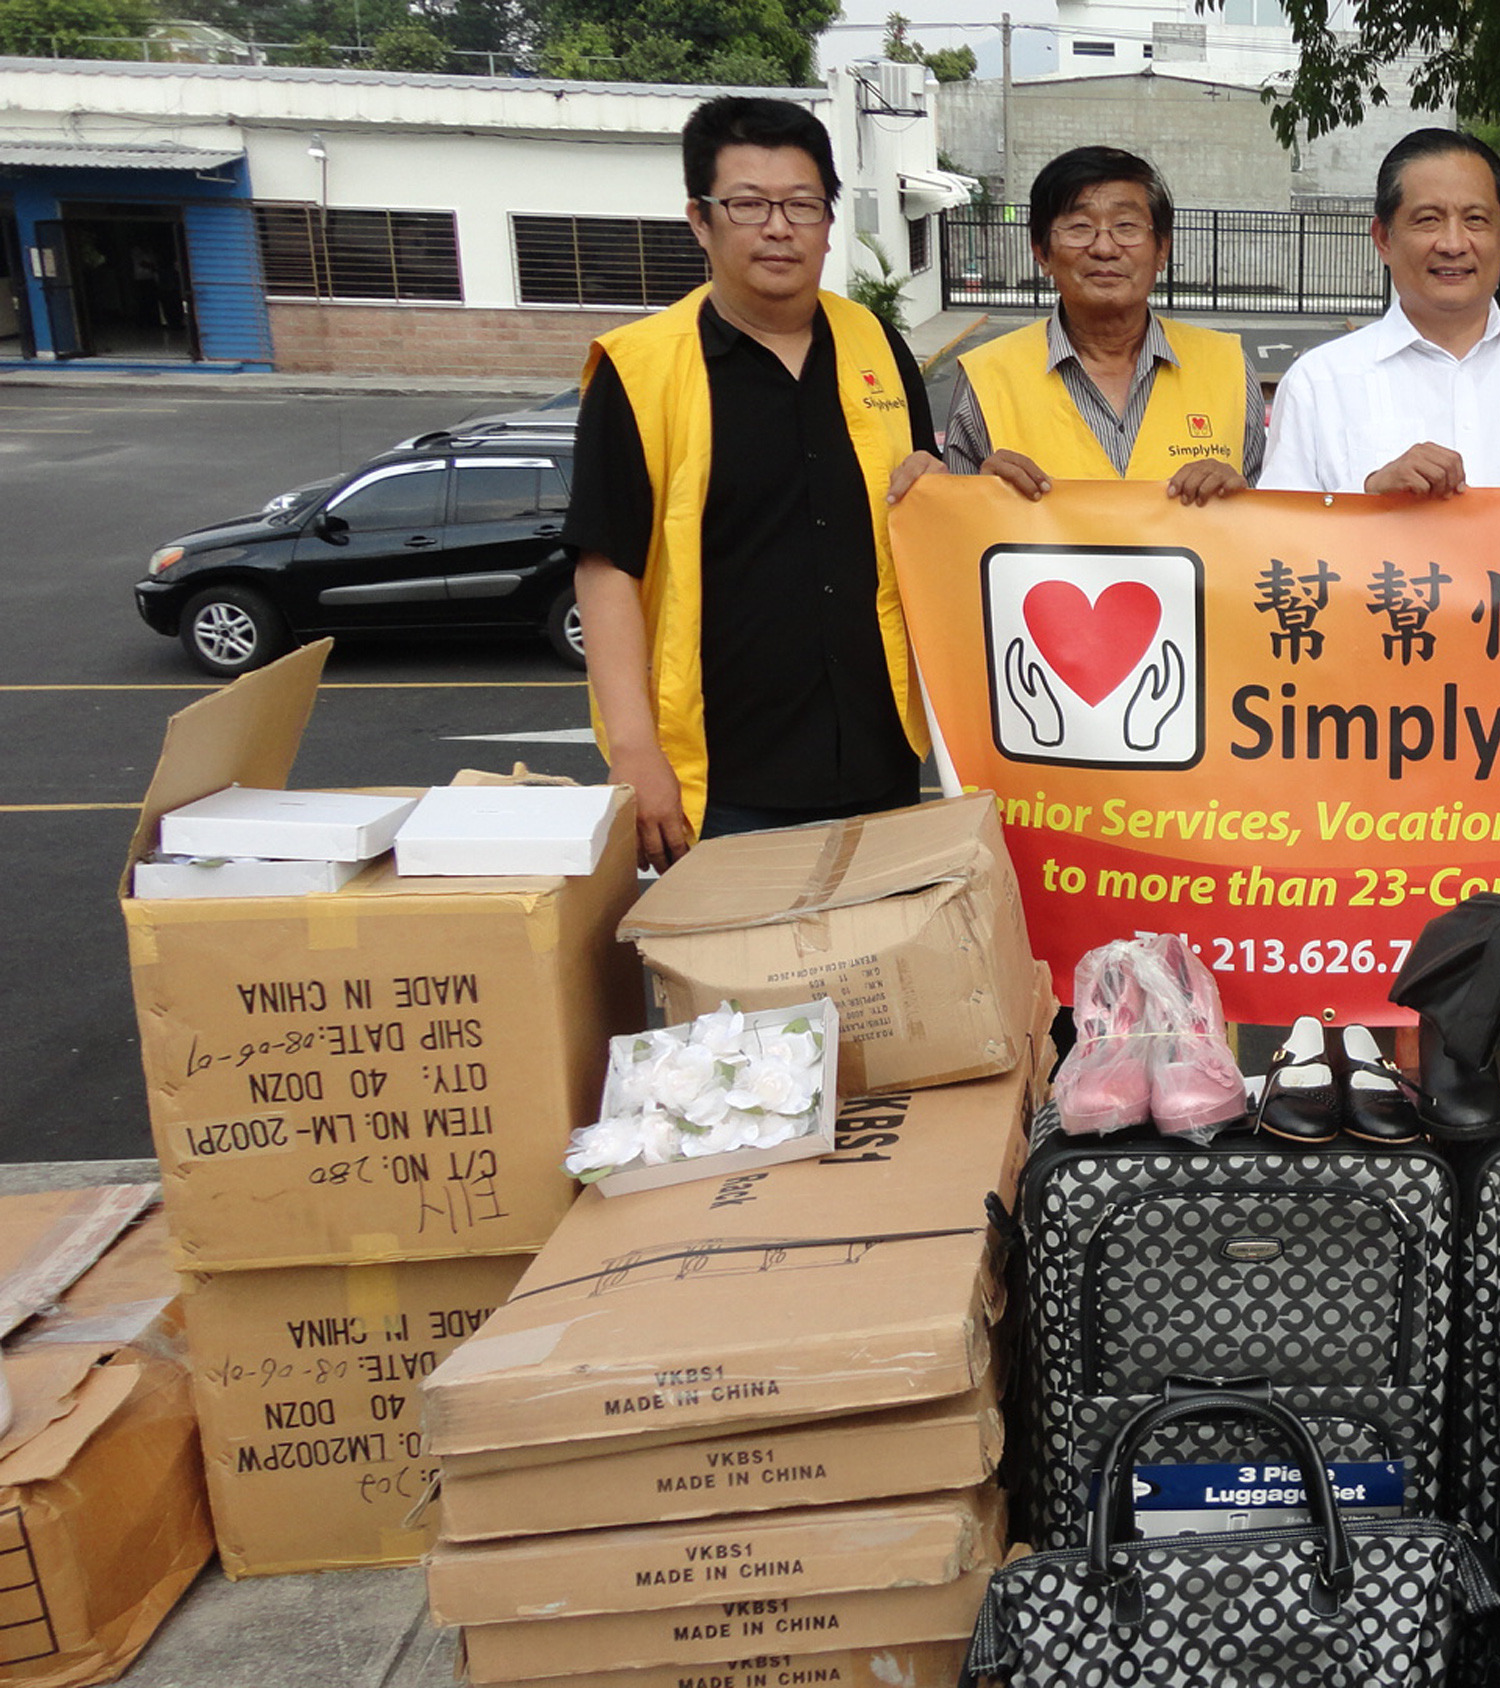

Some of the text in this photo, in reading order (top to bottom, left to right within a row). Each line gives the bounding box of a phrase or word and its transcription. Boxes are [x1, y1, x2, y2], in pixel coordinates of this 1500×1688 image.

[962, 785, 1092, 833] nior
[1101, 798, 1302, 847] Services,
[1043, 859, 1086, 893] to
[1098, 870, 1212, 905] more
[1228, 867, 1336, 907] than
[236, 973, 480, 1014] MADE IN CHINA
[319, 1022, 405, 1055] DATE:
[420, 1019, 483, 1050] SHIP
[249, 1062, 489, 1104] QTY: 40 DOZN
[365, 1110, 411, 1140] NO:
[424, 1105, 492, 1138] ITEM
[383, 1152, 430, 1184] NO:
[446, 1149, 498, 1181] C/T
[654, 1364, 726, 1388] VKBS1
[264, 1394, 406, 1430] 40 DOZN
[604, 1379, 781, 1416] MADE IN CHINA
[237, 1434, 387, 1473] LM2002PW
[706, 1449, 775, 1468] VKBS1
[656, 1463, 828, 1494] MADE IN CHINA
[1238, 1465, 1335, 1483] 3 Pie
[685, 1543, 753, 1563] VKBS1
[635, 1557, 805, 1588] MADE IN CHINA
[723, 1599, 790, 1618] VKBS1
[673, 1614, 840, 1642] MADE IN CHINA
[747, 1674, 767, 1688] IN
[778, 1668, 841, 1687] CHINA
